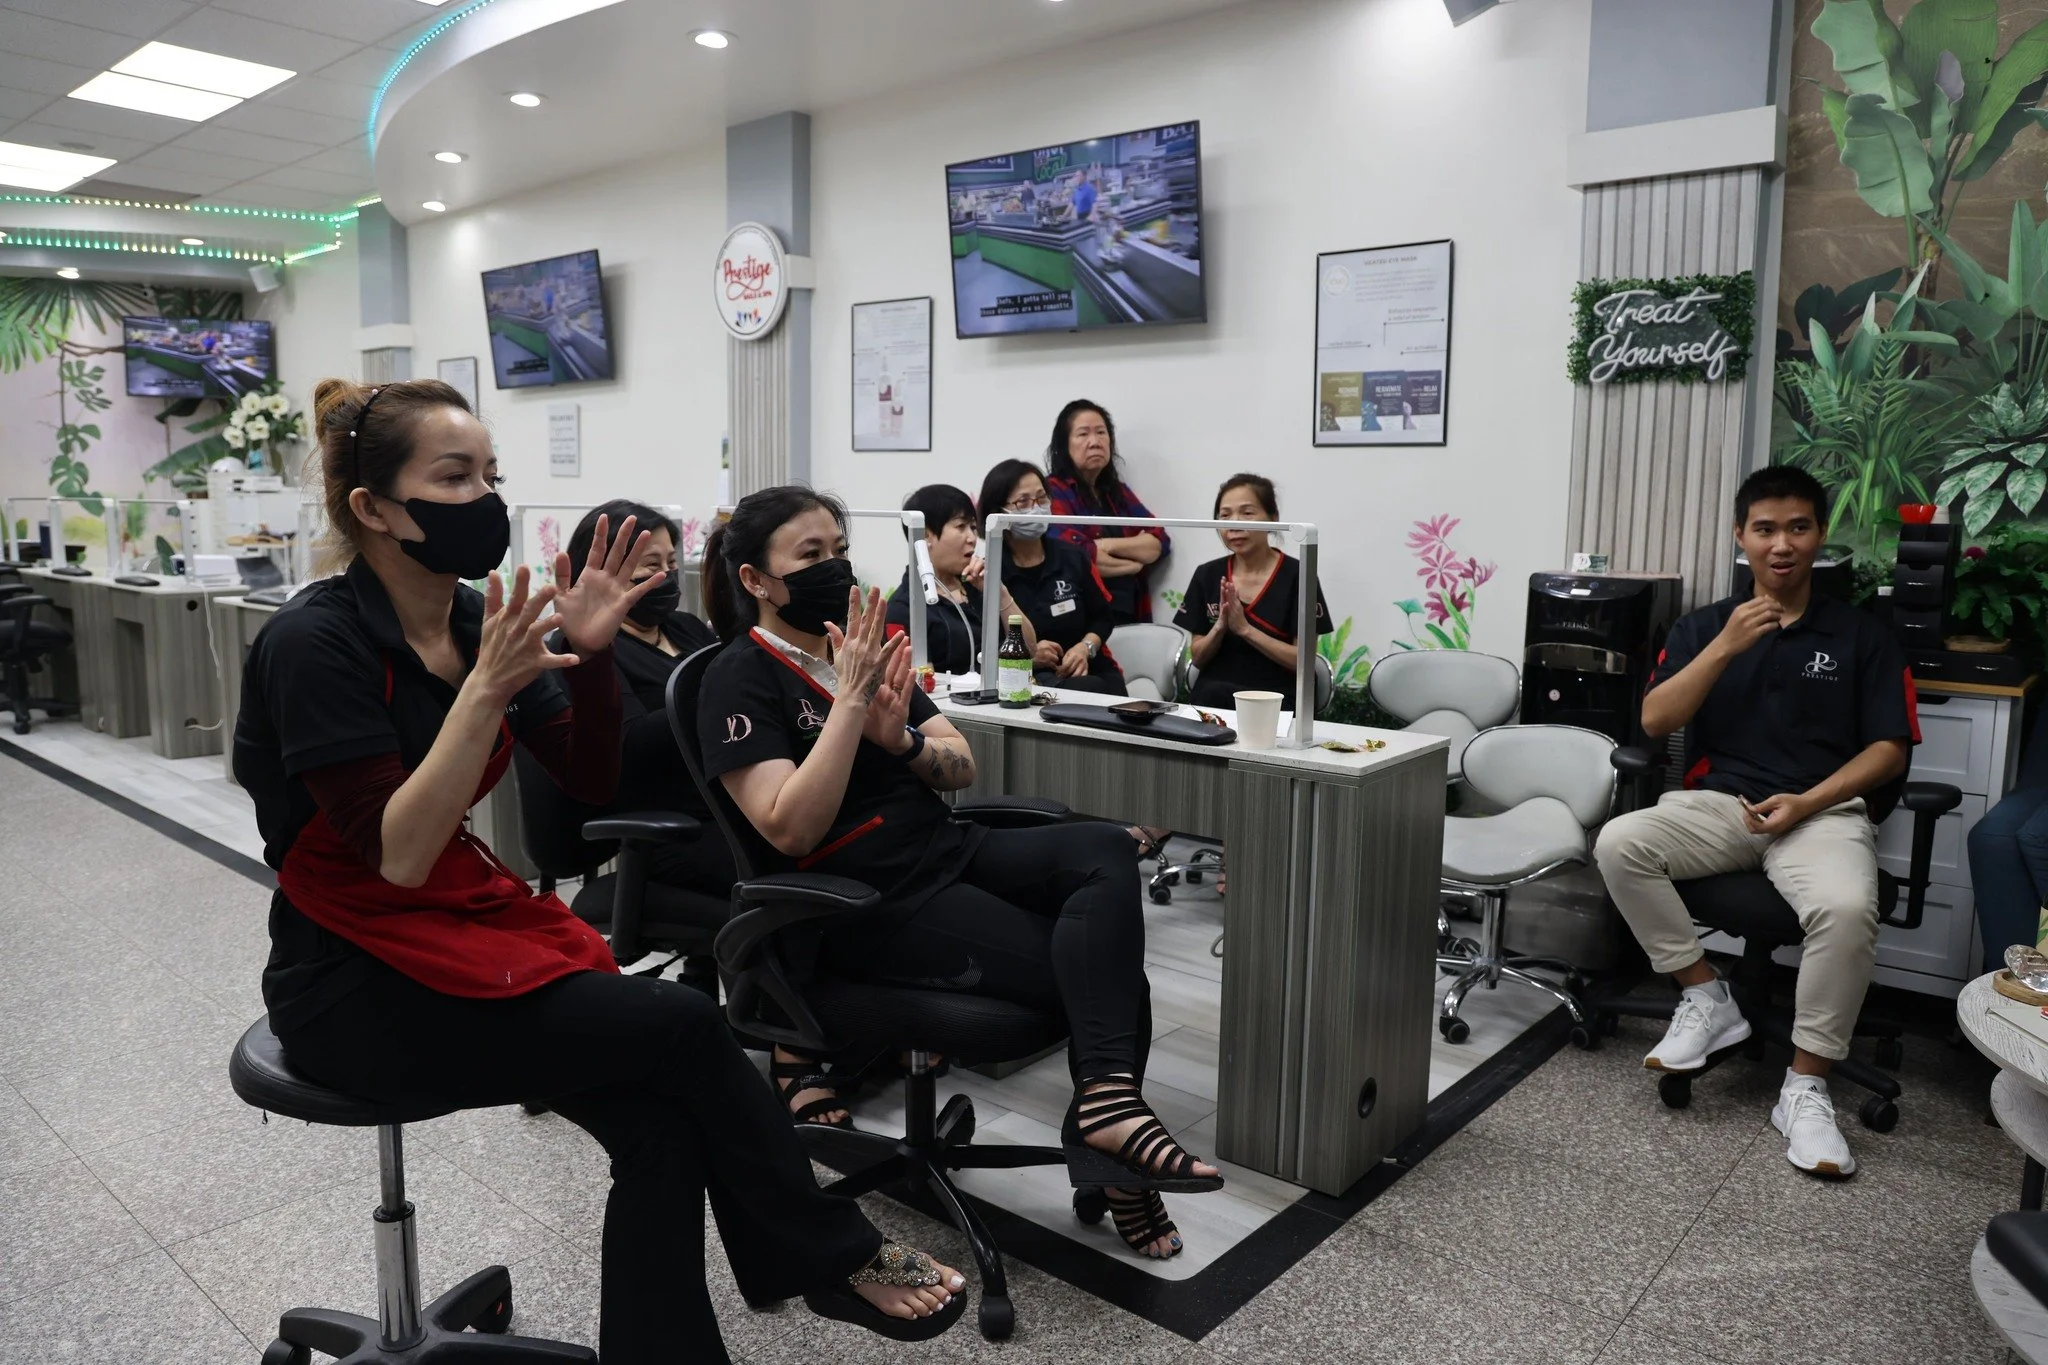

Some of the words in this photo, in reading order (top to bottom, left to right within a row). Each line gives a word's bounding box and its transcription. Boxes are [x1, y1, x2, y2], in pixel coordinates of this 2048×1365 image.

[723, 255, 771, 295] Prestige
[1042, 292, 1055, 301] tell
[1593, 286, 1722, 335] Treat
[1587, 329, 1738, 383] Yourself
[1801, 672, 1838, 681] PRESTIGE
